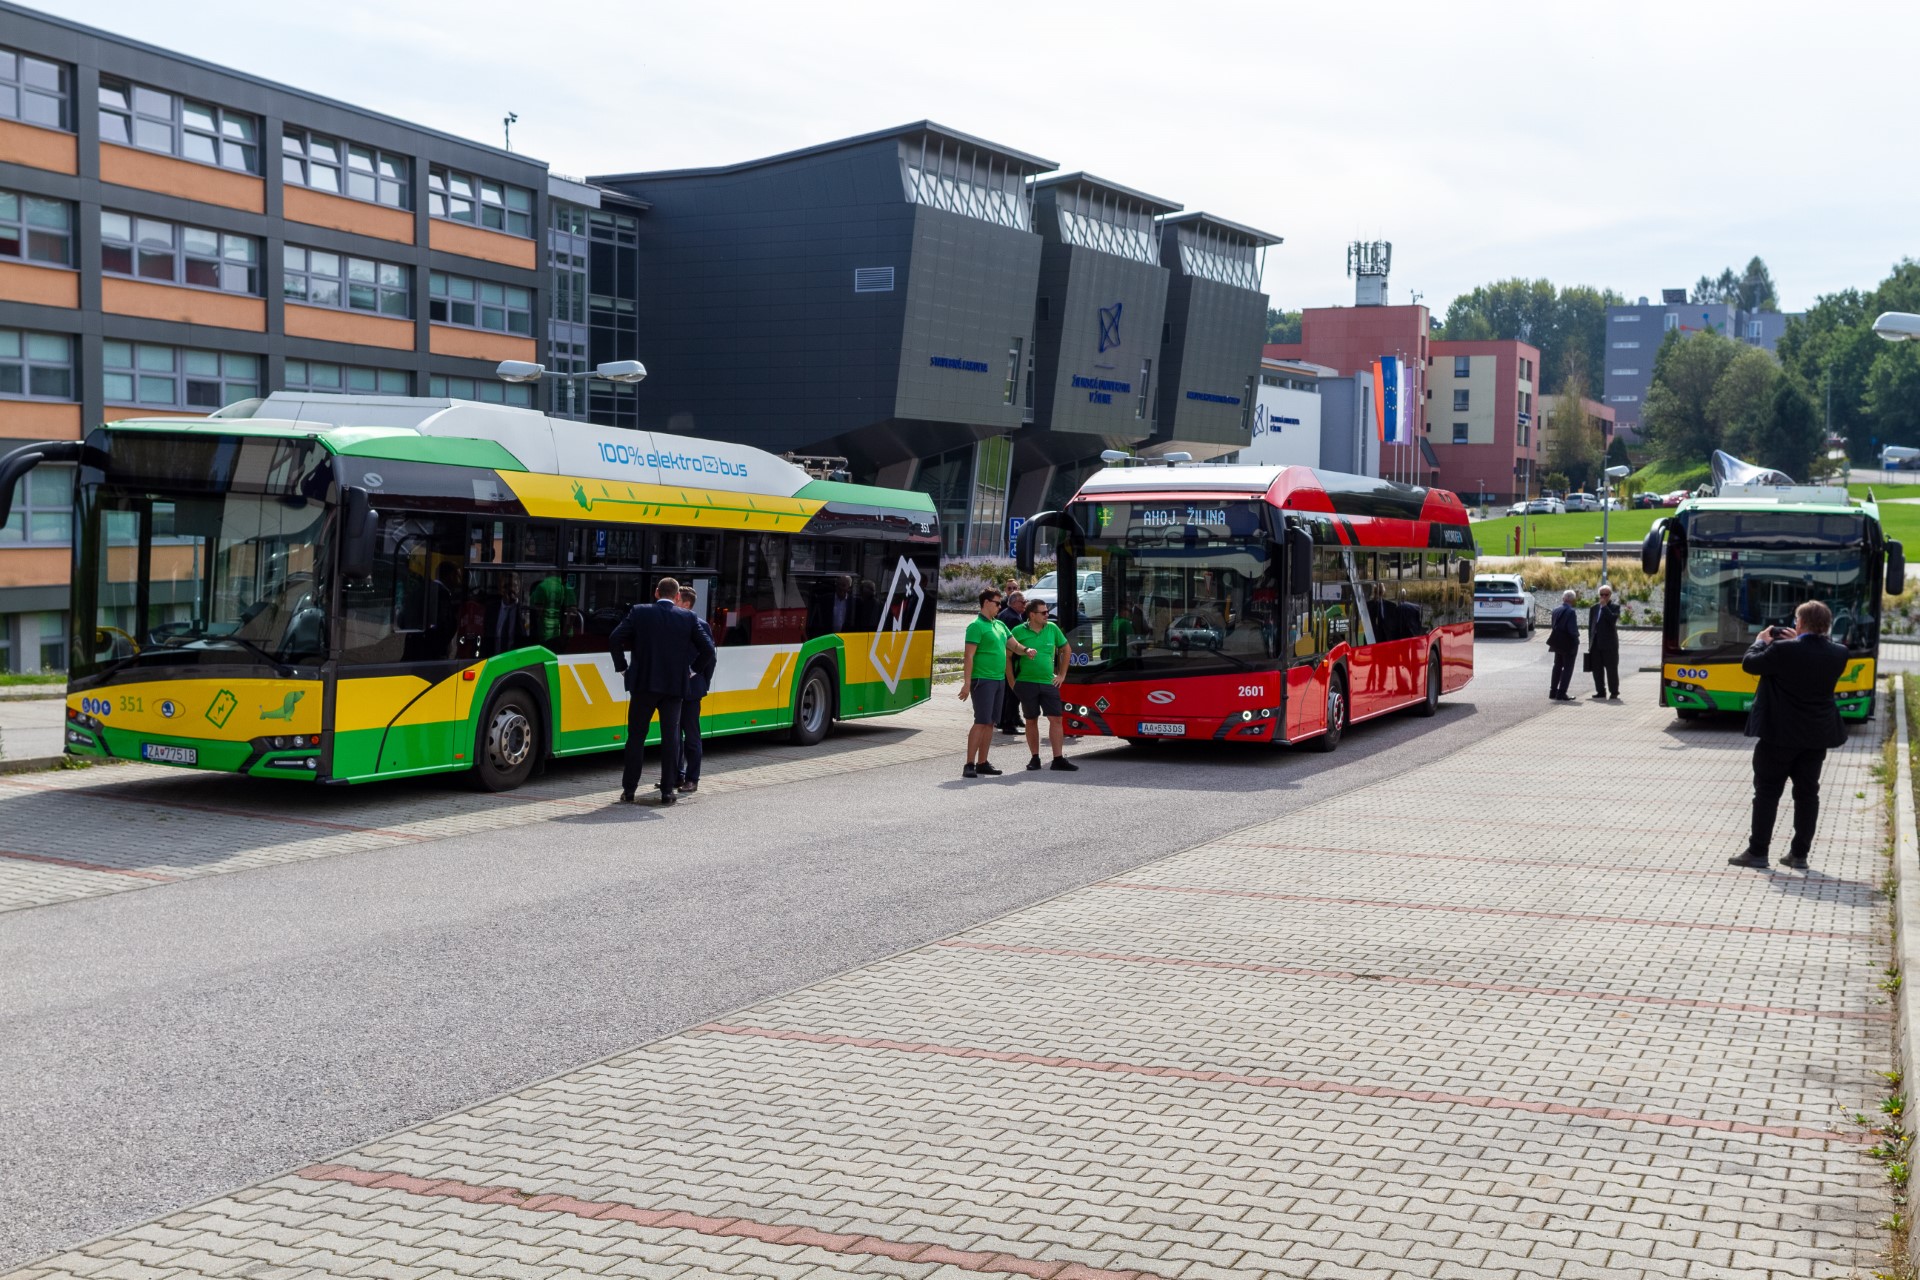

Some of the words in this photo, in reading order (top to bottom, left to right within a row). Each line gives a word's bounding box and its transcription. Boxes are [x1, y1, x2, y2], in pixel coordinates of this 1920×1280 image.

[598, 442, 645, 466] 100%
[1143, 510, 1180, 526] AHOJ,
[1186, 507, 1226, 526] ŽILINA
[920, 522, 931, 533] 351
[1238, 685, 1264, 697] 2601
[119, 695, 144, 712] 351
